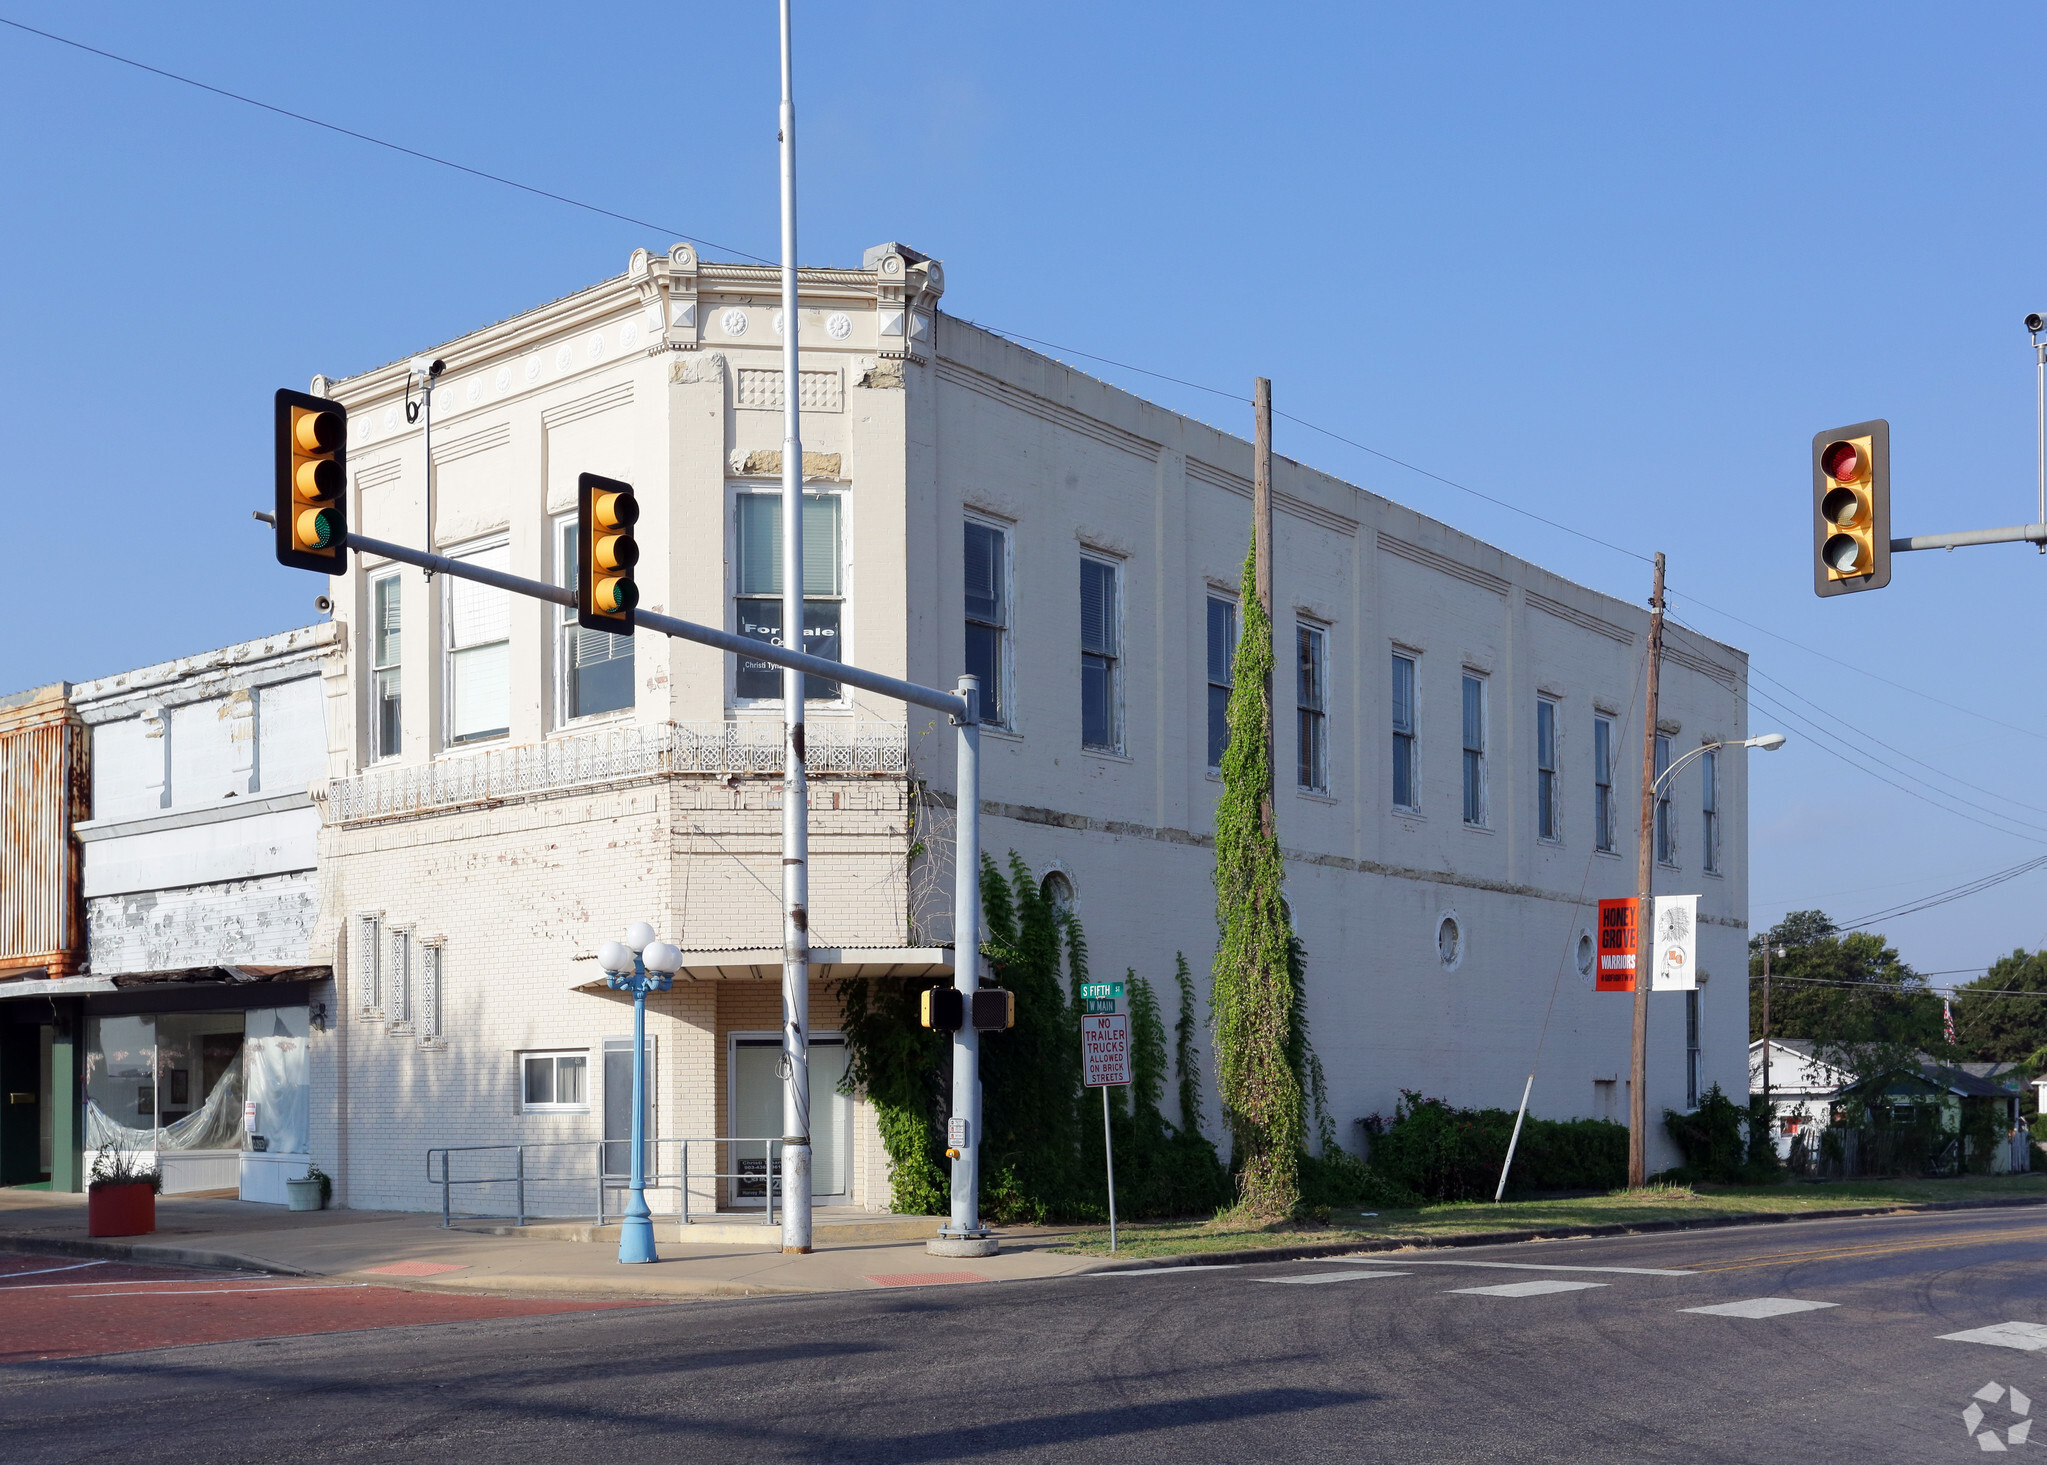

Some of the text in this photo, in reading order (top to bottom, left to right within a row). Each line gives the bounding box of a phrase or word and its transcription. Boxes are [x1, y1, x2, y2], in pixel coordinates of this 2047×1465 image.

[745, 624, 835, 636] For ale
[1603, 907, 1636, 927] HONEY
[1603, 929, 1635, 948] GROVE
[1601, 954, 1636, 969] WARRIORS
[1083, 986, 1088, 997] S
[1090, 985, 1110, 996] FIFTH
[1090, 1001, 1113, 1011] W MAIN
[1098, 1019, 1110, 1029] NO
[1086, 1030, 1125, 1041] TRAILER
[1087, 1042, 1125, 1053] TRUCKS
[1090, 1054, 1123, 1063] ALLOWED
[1103, 1063, 1123, 1072] BRICK
[1092, 1073, 1123, 1082] STREETS
